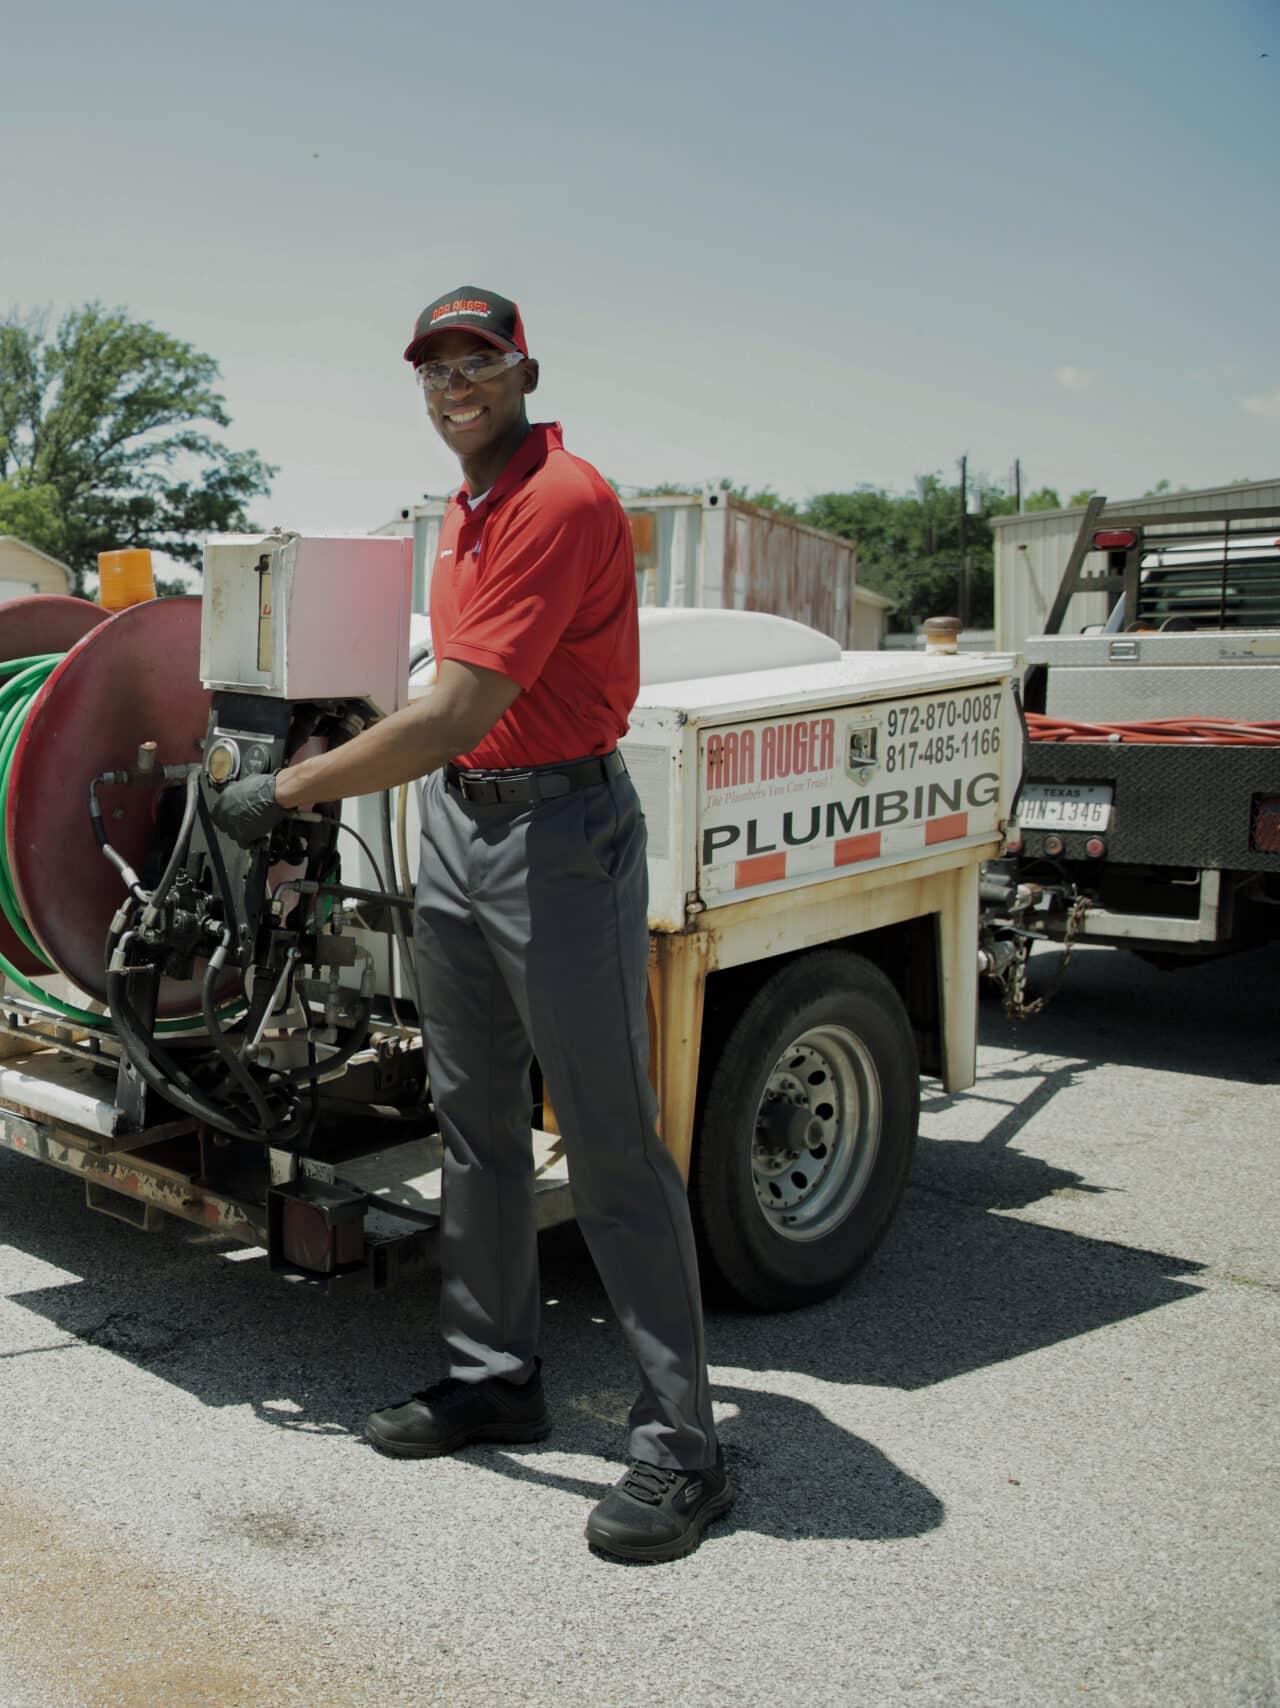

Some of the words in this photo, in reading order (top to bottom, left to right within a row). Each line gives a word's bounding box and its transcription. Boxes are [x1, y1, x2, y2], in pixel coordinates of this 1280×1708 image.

[887, 693, 1002, 737] 972-870-0087
[706, 729, 755, 791] AAA
[760, 718, 836, 782] AUGER
[885, 727, 1001, 773] 817-485-1166
[1043, 788, 1081, 799] TEXAS
[702, 772, 1000, 866] PLUMBING
